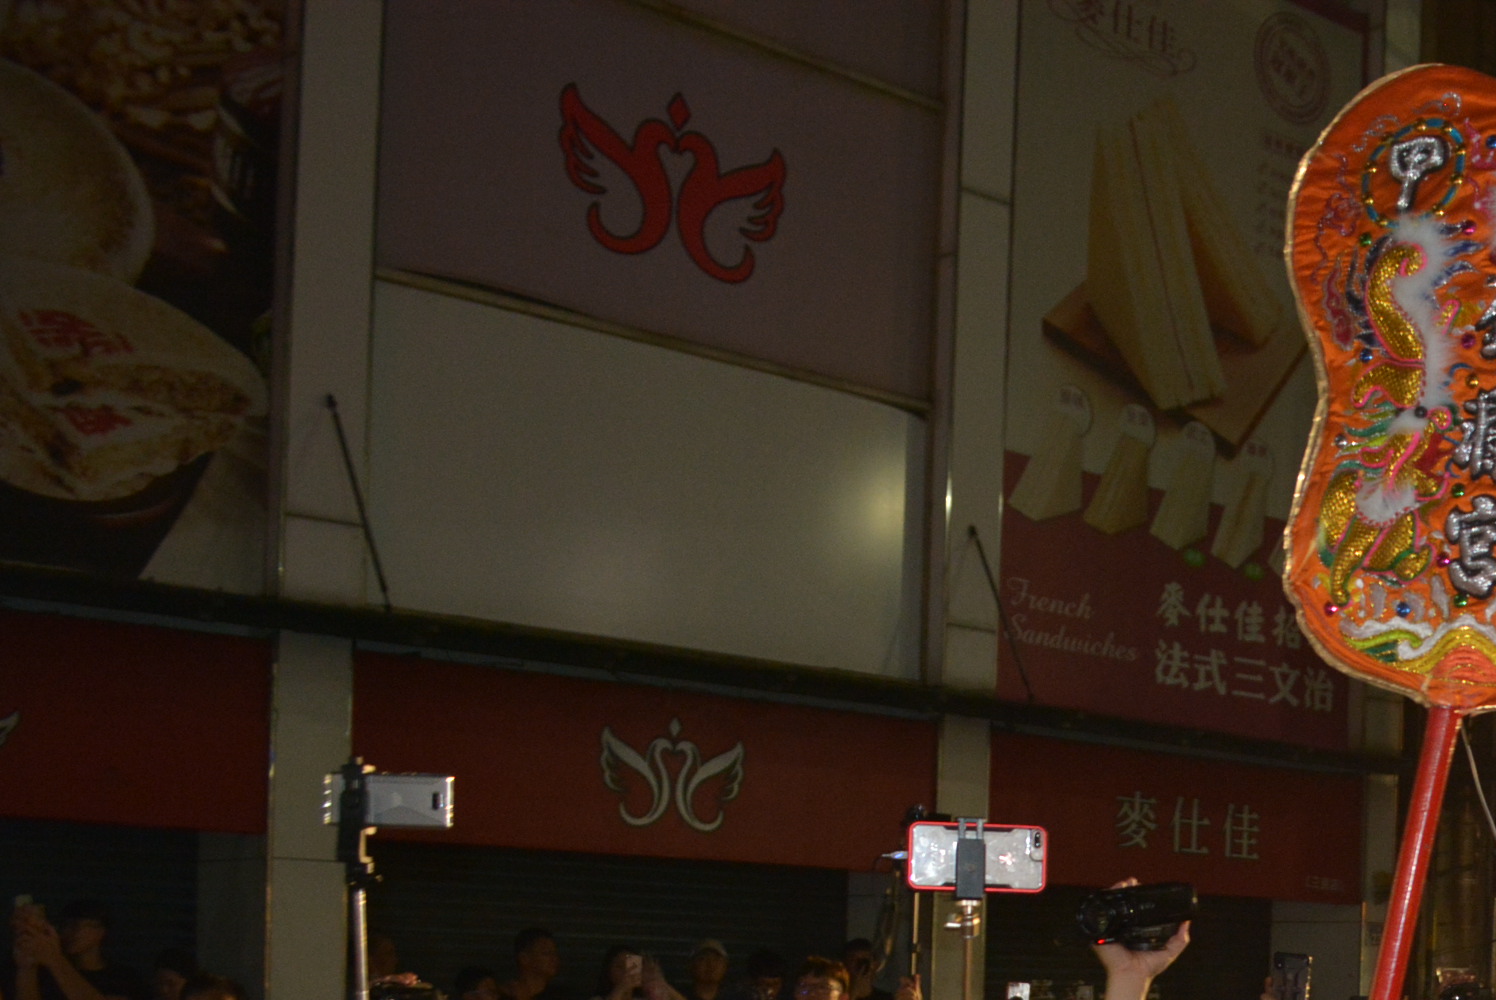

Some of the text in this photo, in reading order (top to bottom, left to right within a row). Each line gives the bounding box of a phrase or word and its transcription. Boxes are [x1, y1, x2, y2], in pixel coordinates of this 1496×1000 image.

[1390, 136, 1450, 212] 甲
[1004, 576, 1094, 620] French
[1003, 612, 1137, 663] Sandwiches
[1154, 639, 1335, 713] 法式三文治
[1115, 790, 1261, 861] 麥仕佳
